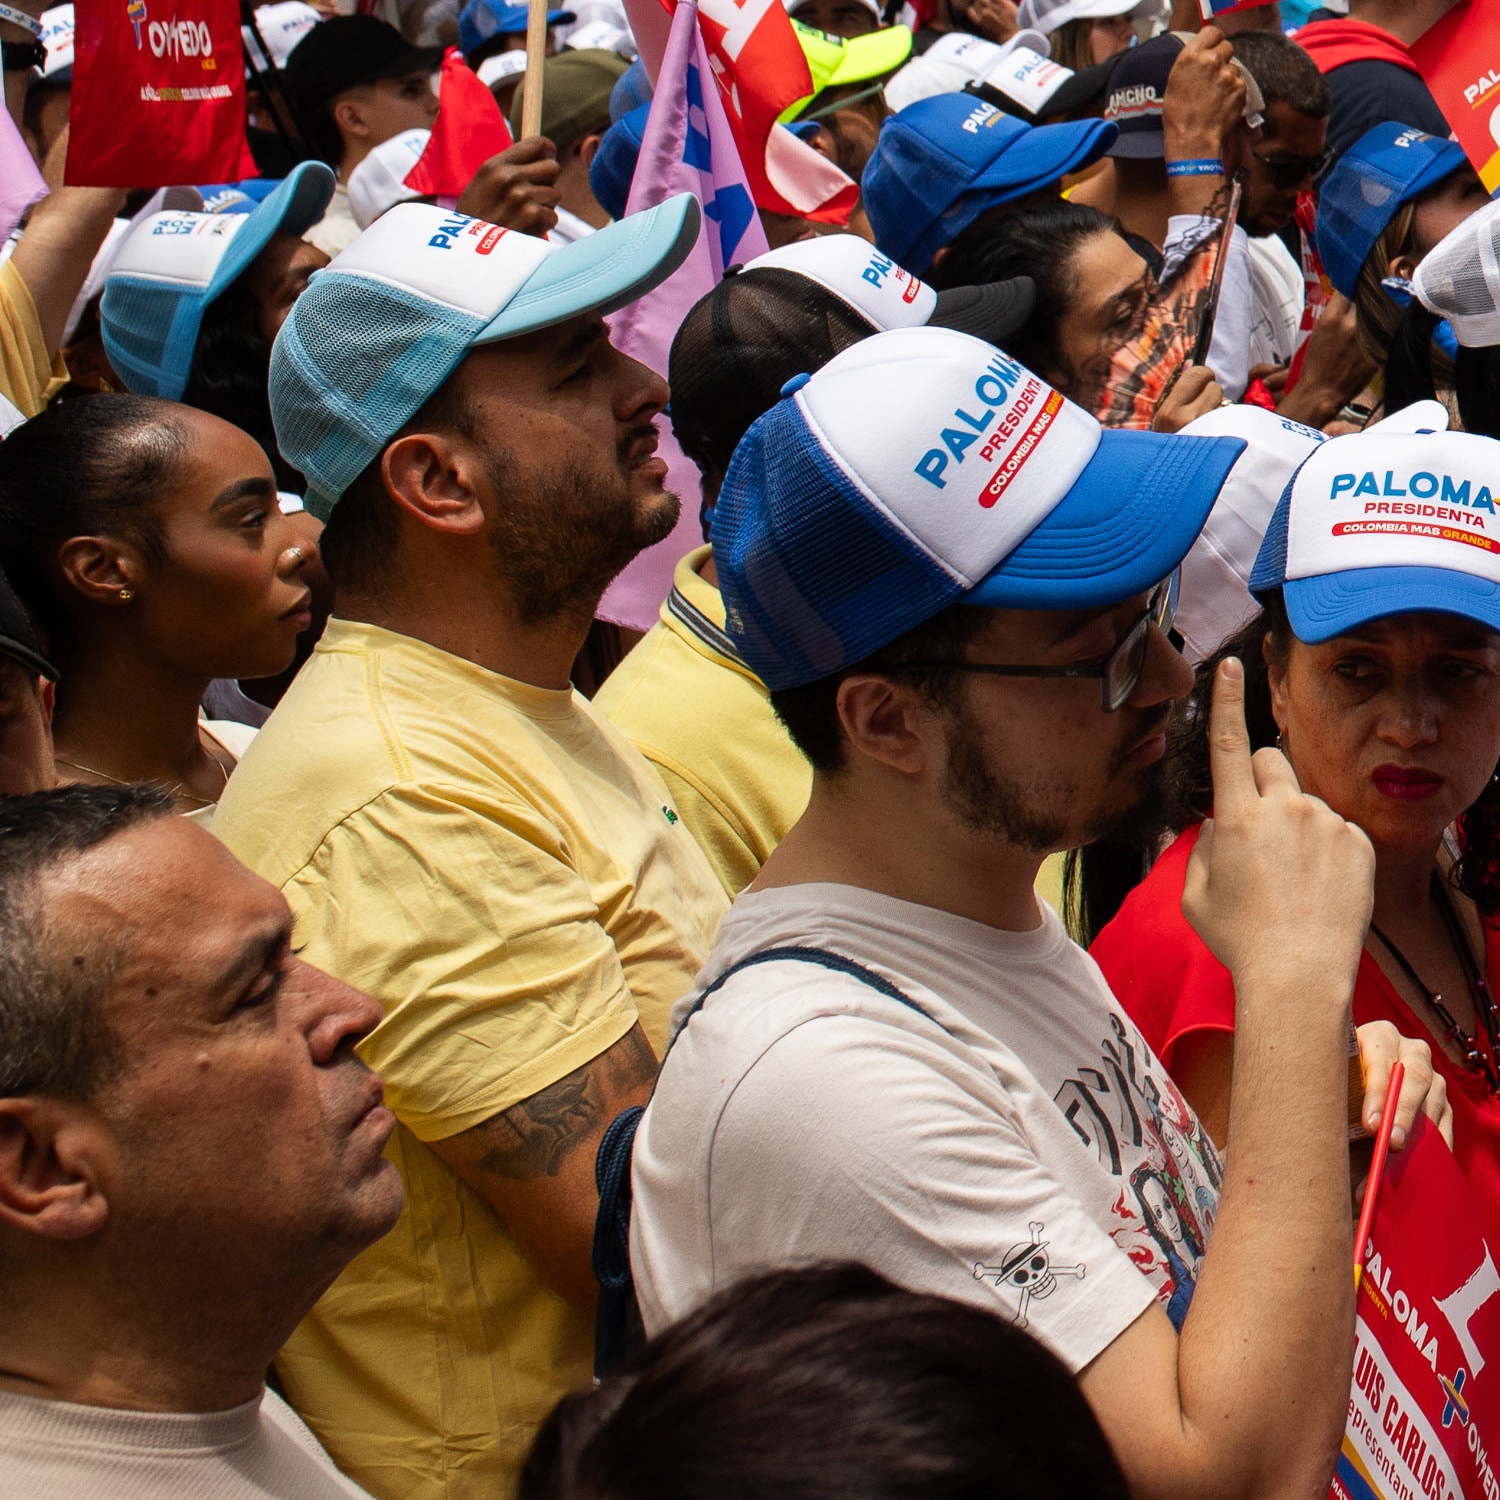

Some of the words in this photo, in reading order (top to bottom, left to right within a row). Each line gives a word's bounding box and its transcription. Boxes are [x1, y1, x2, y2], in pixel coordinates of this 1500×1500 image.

[148, 14, 212, 62] OVIEDO
[914, 353, 1023, 490] PALOMA
[979, 377, 1042, 462] PRESIDENTA
[989, 434, 1037, 495] COLOMBIA
[1034, 412, 1051, 437] MAS
[1343, 523, 1407, 533] COLOMBIA
[1411, 525, 1440, 536] MAS
[1443, 529, 1492, 550] GRANDE
[1364, 502, 1485, 529] PRESIDENTA
